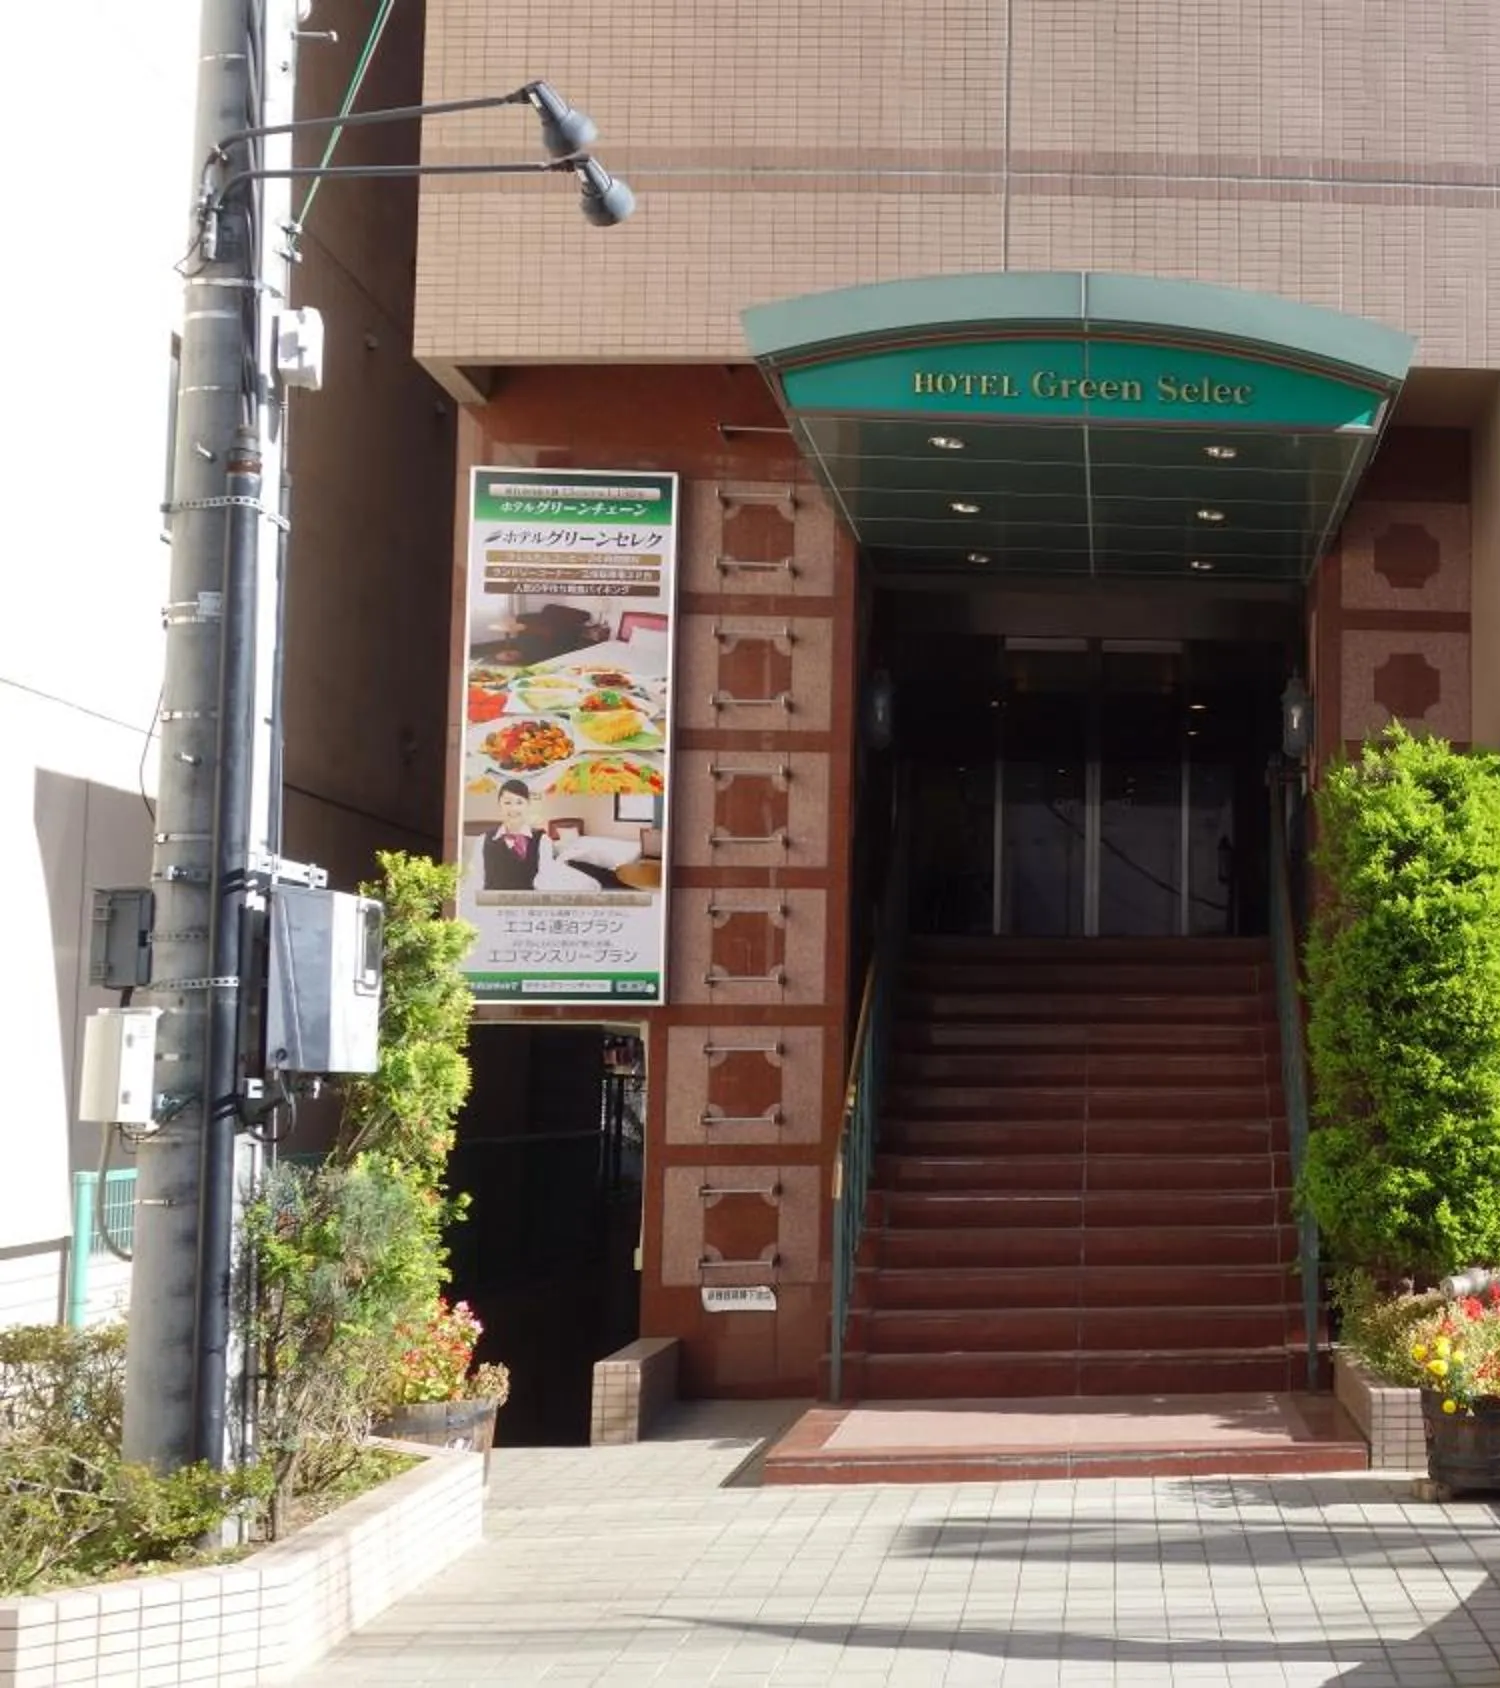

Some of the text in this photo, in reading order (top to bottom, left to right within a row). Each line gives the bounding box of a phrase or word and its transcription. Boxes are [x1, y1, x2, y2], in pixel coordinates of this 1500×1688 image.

[913, 371, 1252, 404] HOTEL Green Selec
[500, 500, 648, 517] ホテルグリーンチェーン
[502, 528, 664, 548] ホテルグリーンセレク
[488, 949, 638, 964] エコマンスリープラン
